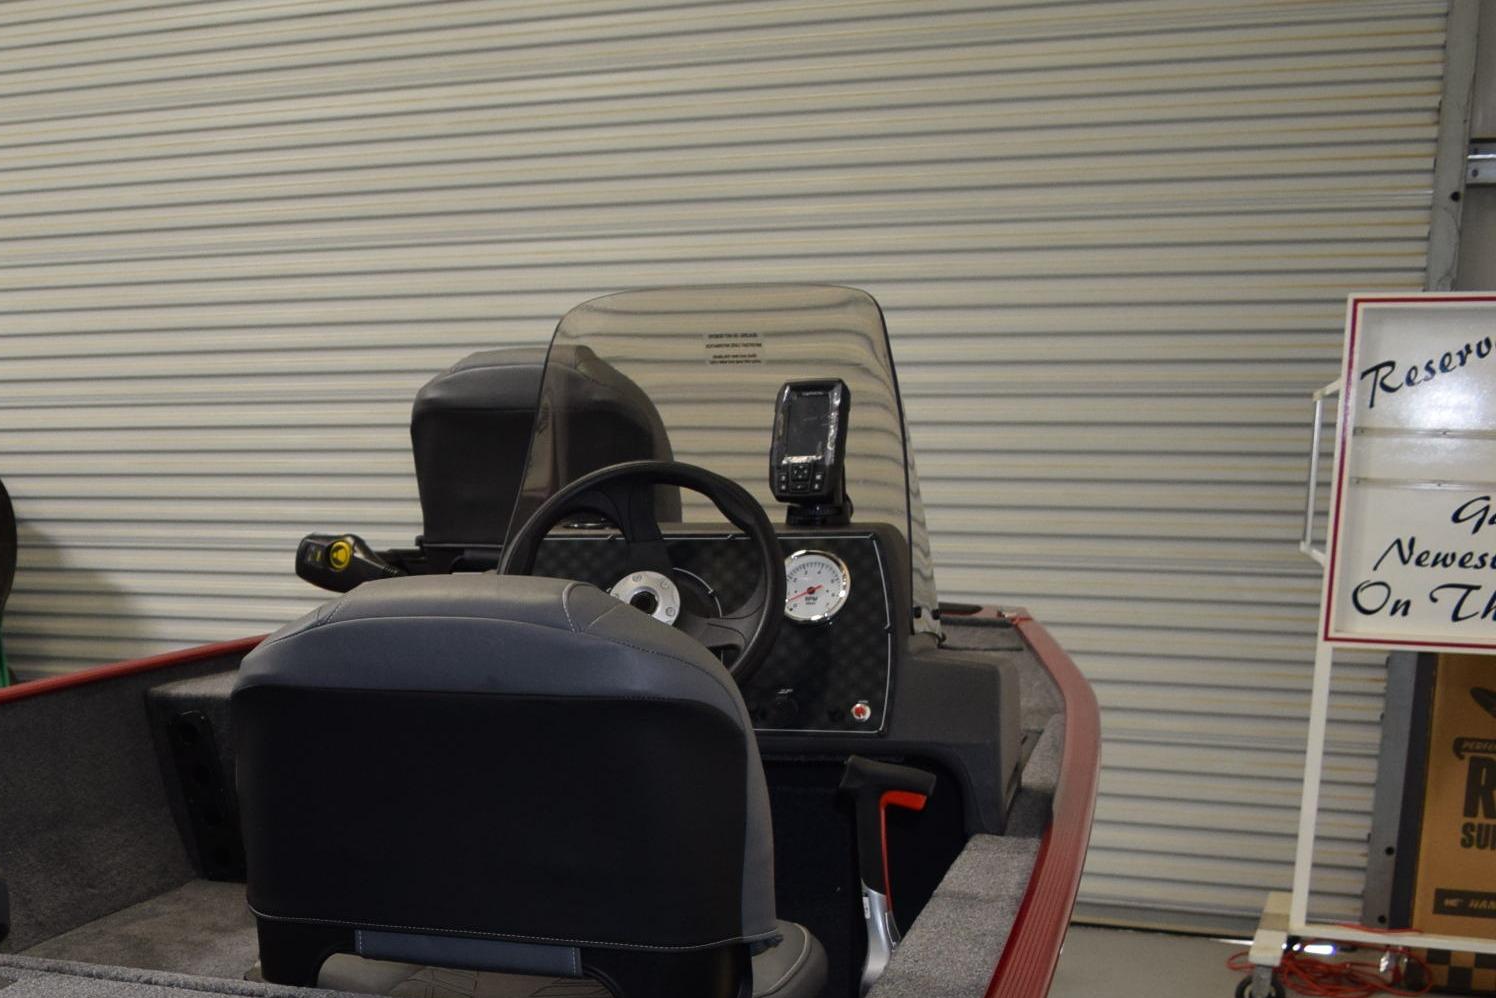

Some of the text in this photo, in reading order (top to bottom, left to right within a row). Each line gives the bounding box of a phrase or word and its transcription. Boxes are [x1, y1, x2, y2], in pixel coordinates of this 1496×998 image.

[1360, 336, 1496, 408] Reserv
[1352, 580, 1411, 617] On
[1460, 821, 1496, 851] SU
